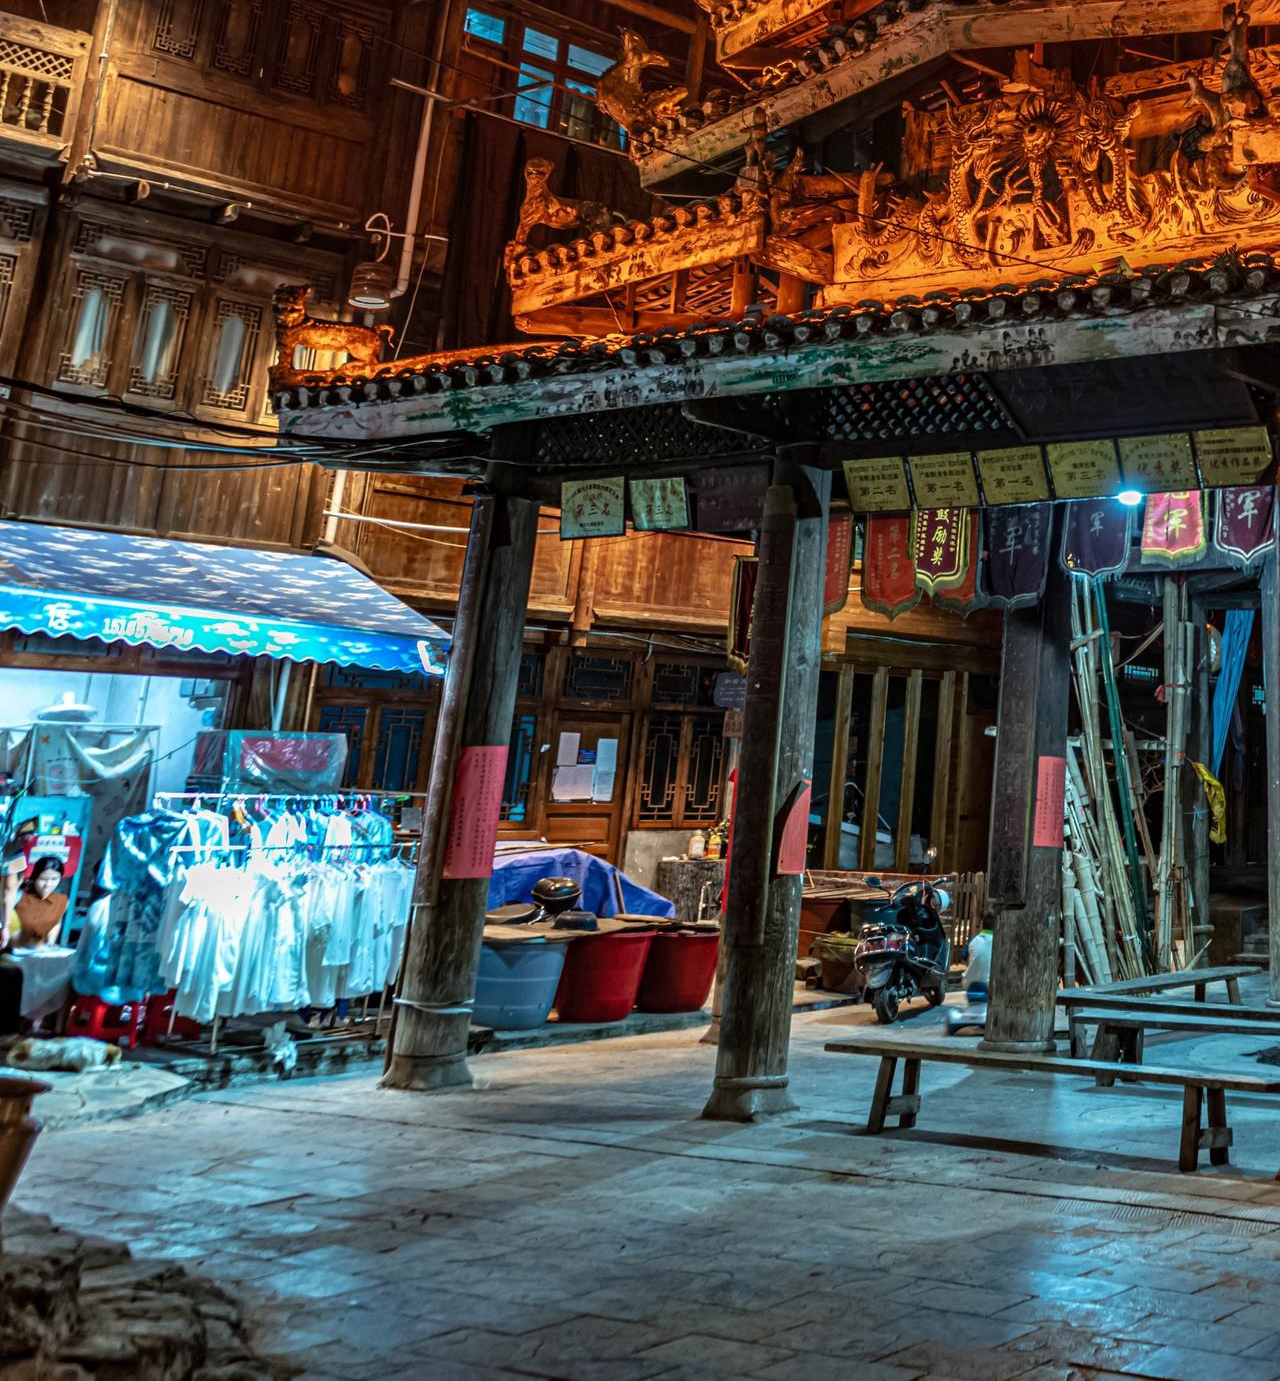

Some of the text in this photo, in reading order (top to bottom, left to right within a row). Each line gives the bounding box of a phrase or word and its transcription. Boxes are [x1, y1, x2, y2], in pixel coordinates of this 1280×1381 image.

[1136, 459, 1182, 477] 优秀奖
[1209, 456, 1263, 470] 优秀作品奖
[994, 475, 1034, 489] 第一名
[1065, 469, 1108, 481] 第三名
[859, 484, 897, 497] 第二名
[925, 480, 965, 494] 第一名
[575, 502, 611, 519] 第三名
[645, 502, 674, 517] 第三名
[931, 509, 950, 566] 鼓励奖
[887, 522, 902, 580] 第二名
